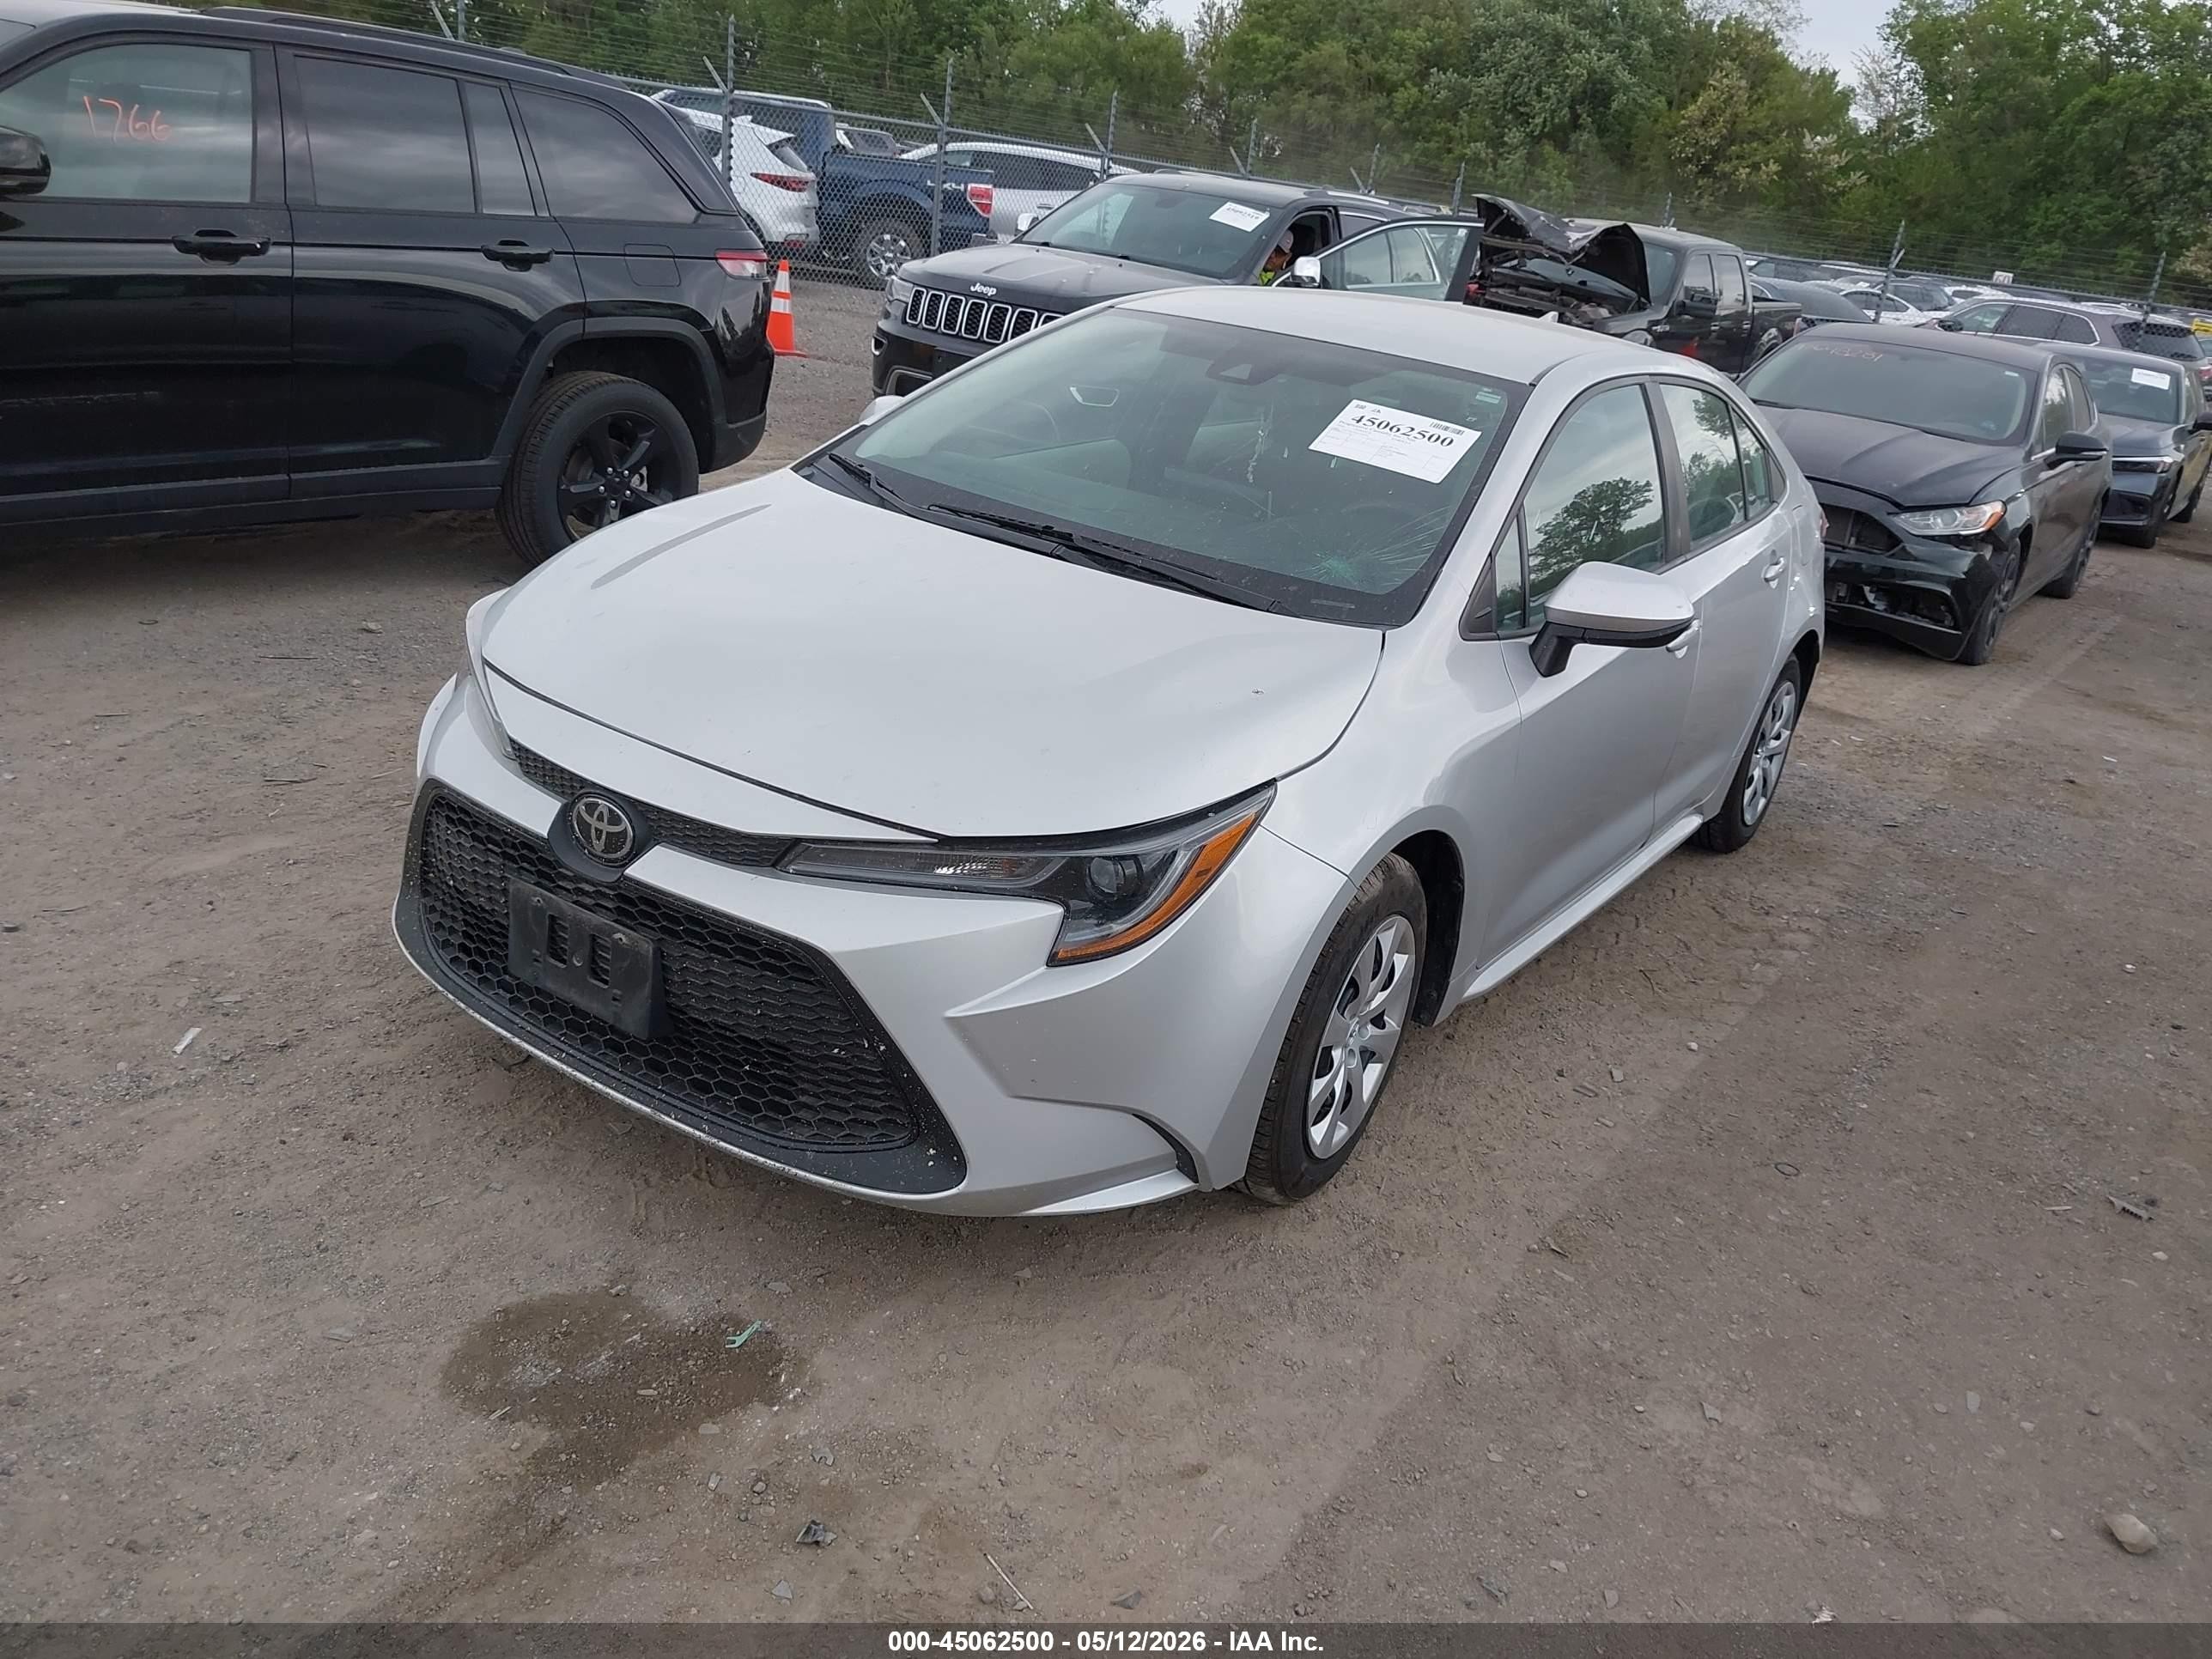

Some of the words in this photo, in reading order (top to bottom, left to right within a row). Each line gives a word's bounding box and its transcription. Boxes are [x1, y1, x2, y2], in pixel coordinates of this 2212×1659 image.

[82, 95, 170, 144] 1766
[969, 282, 997, 296] Jeep
[1351, 414, 1455, 447] 45062500
